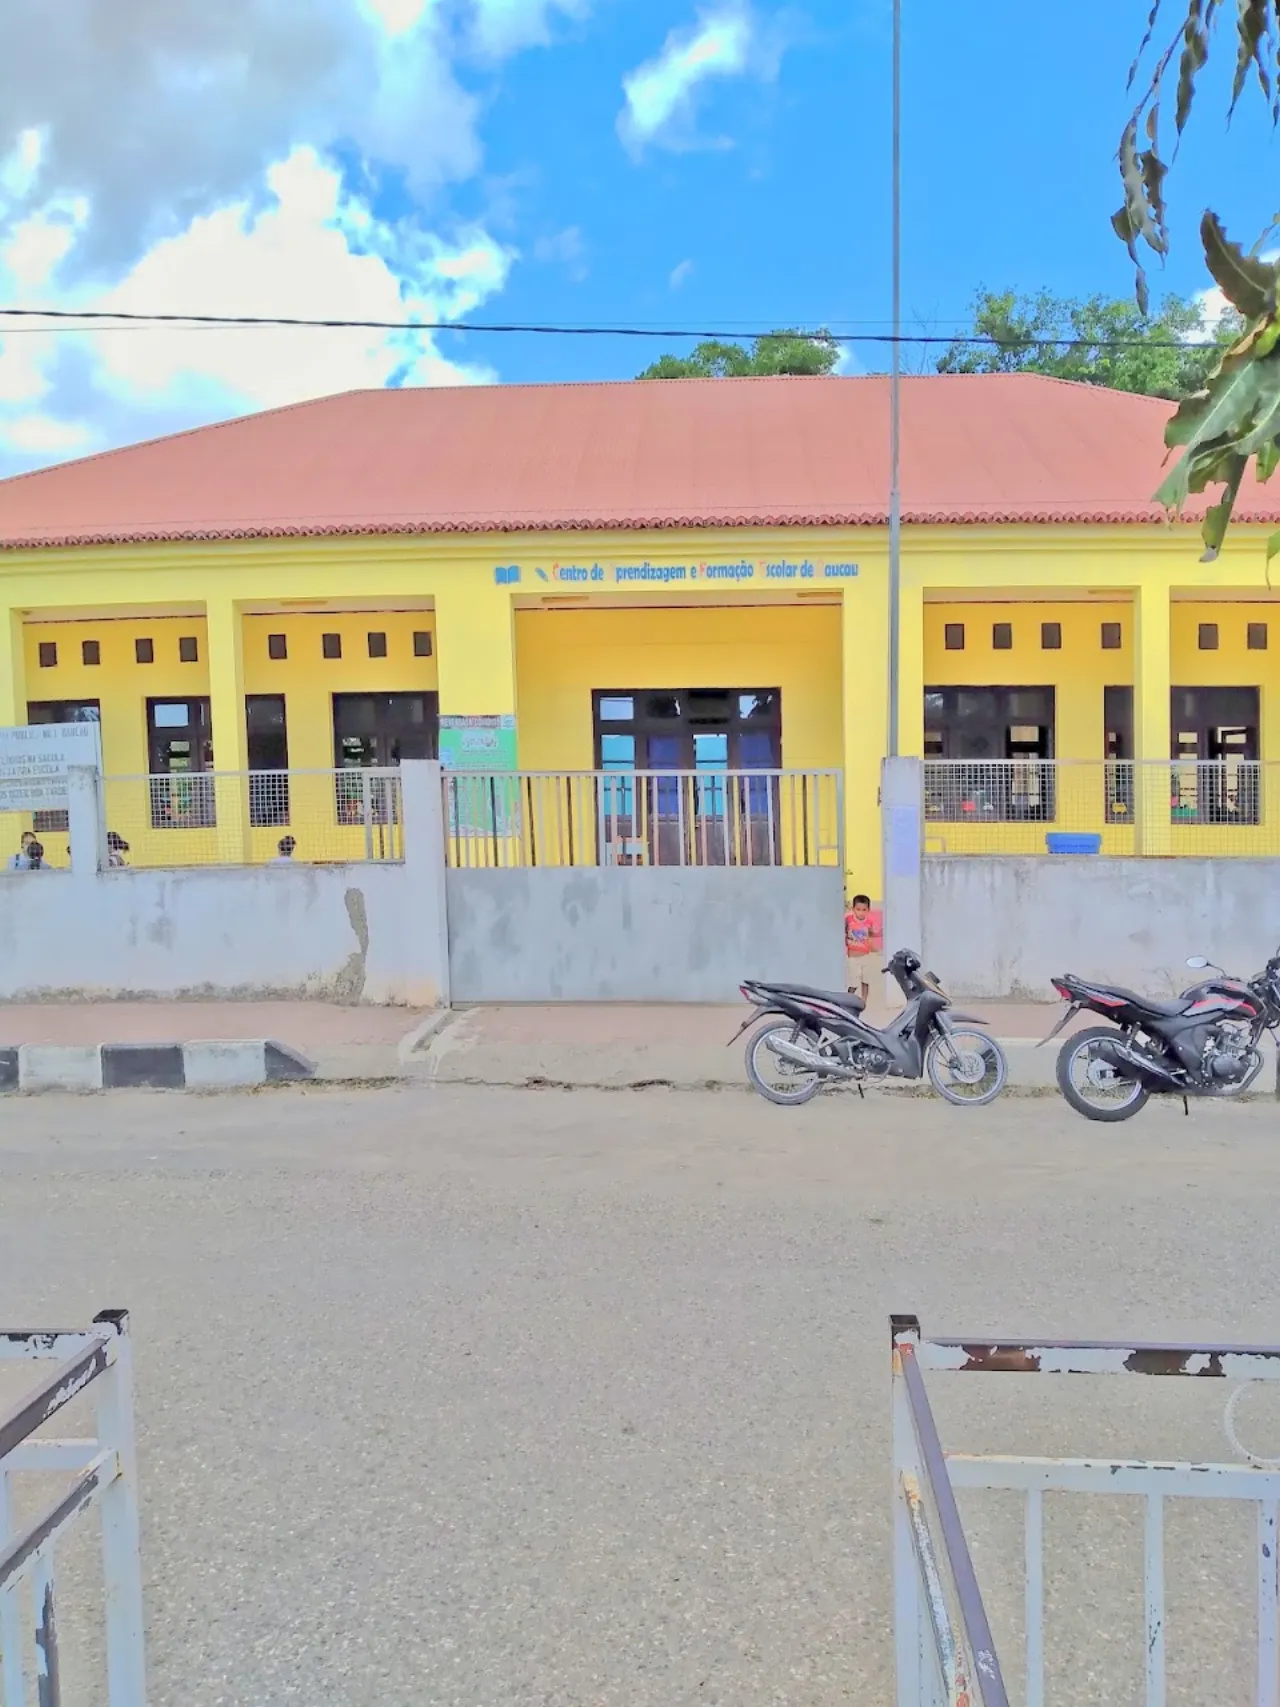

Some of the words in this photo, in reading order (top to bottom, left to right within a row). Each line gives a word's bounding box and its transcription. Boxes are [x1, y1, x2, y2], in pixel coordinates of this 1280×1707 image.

[553, 563, 588, 581] Centro
[590, 562, 604, 581] de
[610, 562, 686, 583] prendizagem
[690, 564, 697, 579] e
[700, 560, 754, 582] Formação
[800, 559, 814, 578] de
[819, 560, 858, 577] aucau
